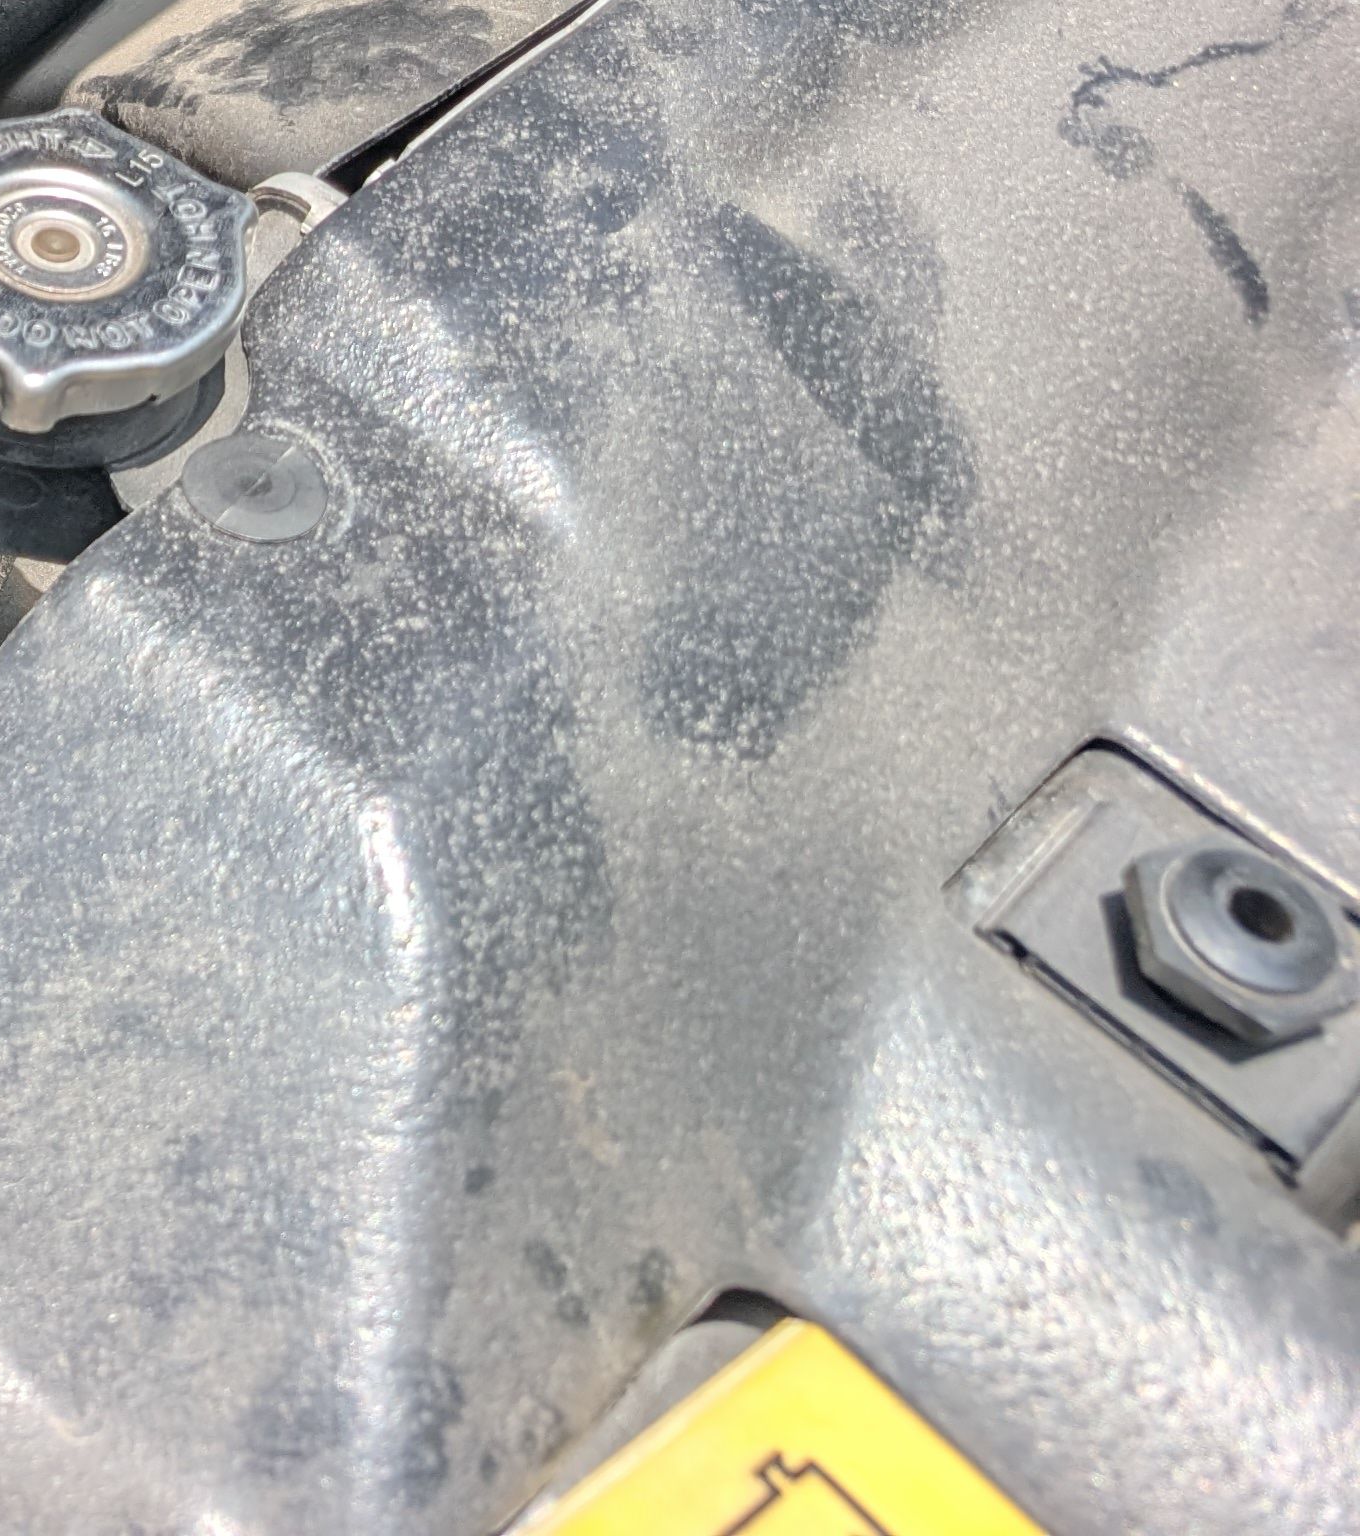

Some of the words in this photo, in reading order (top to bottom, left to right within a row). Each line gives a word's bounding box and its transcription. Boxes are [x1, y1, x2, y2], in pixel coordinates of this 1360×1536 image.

[152, 184, 218, 242] HOT
[153, 248, 220, 325] OPEN
[62, 312, 154, 350] NOT
